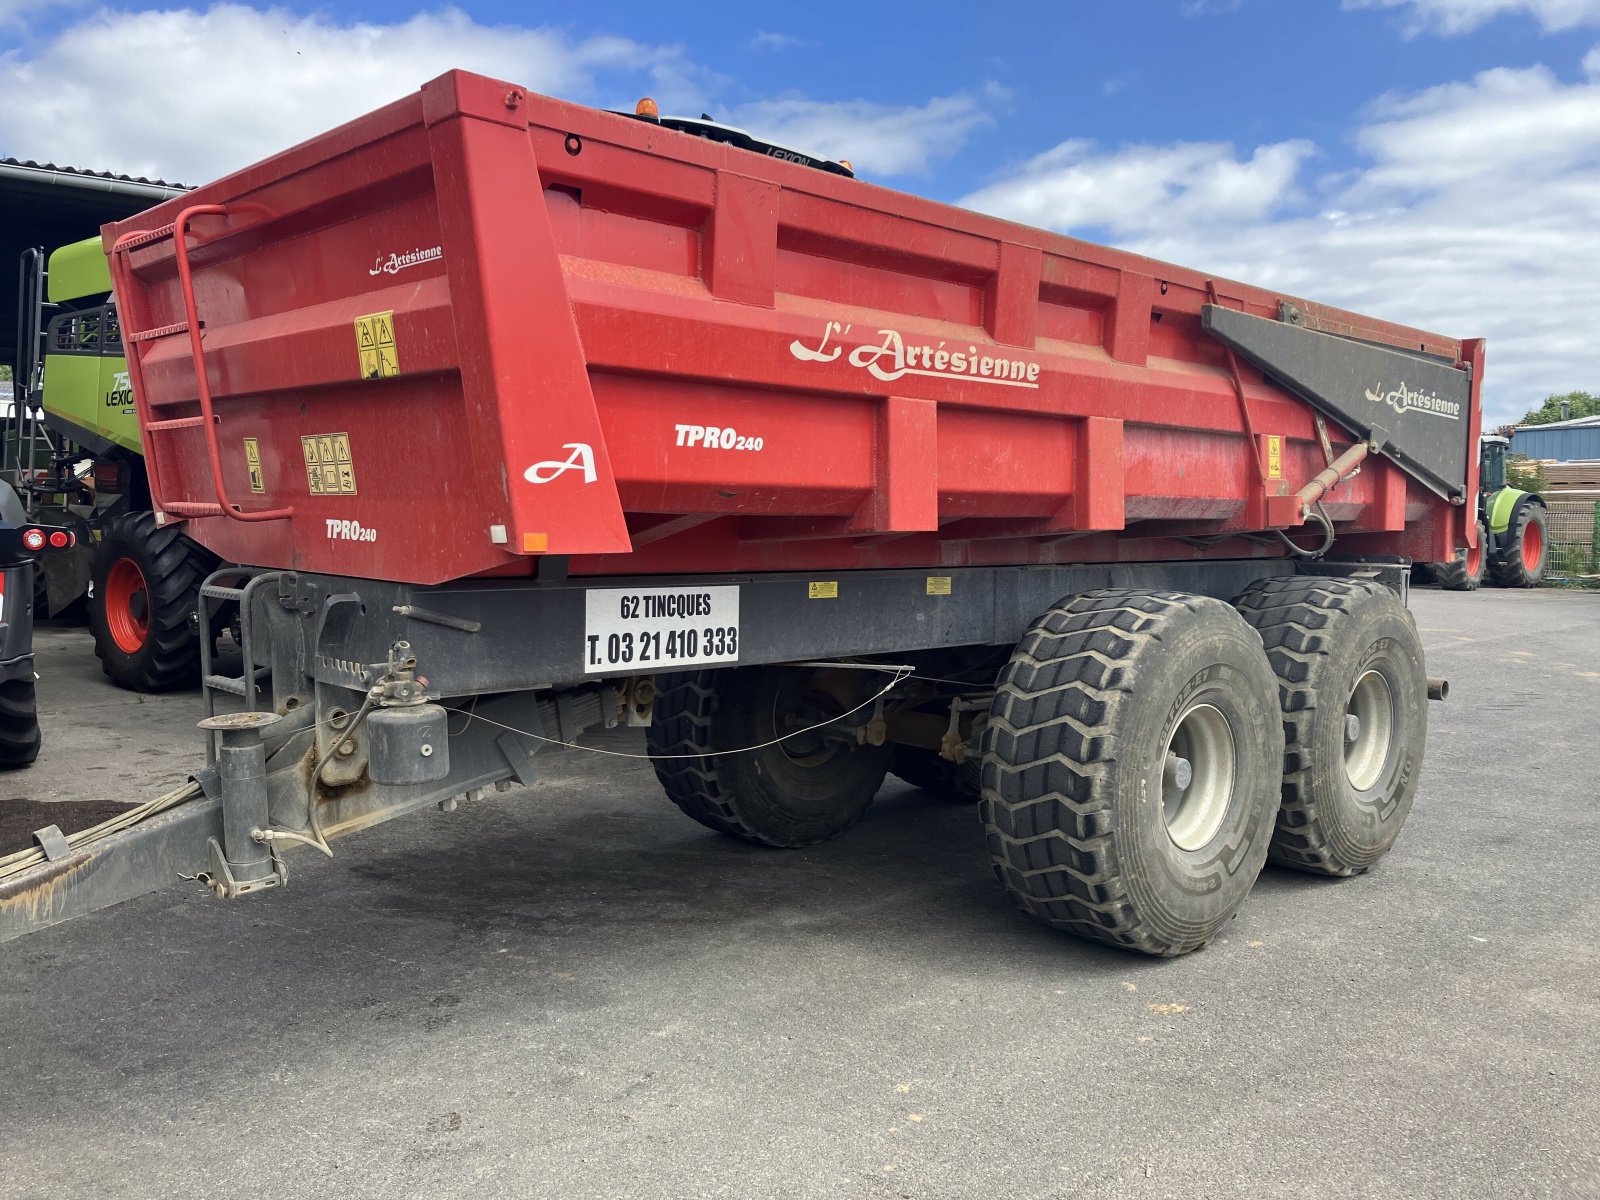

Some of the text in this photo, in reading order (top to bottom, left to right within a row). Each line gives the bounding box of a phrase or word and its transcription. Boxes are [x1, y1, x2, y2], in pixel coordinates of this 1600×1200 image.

[765, 147, 812, 168] LEXION
[113, 371, 132, 392] 75
[523, 443, 598, 484] A
[620, 593, 712, 620] 62 TINCQUES
[587, 626, 738, 665] T. 03 21 410 333
